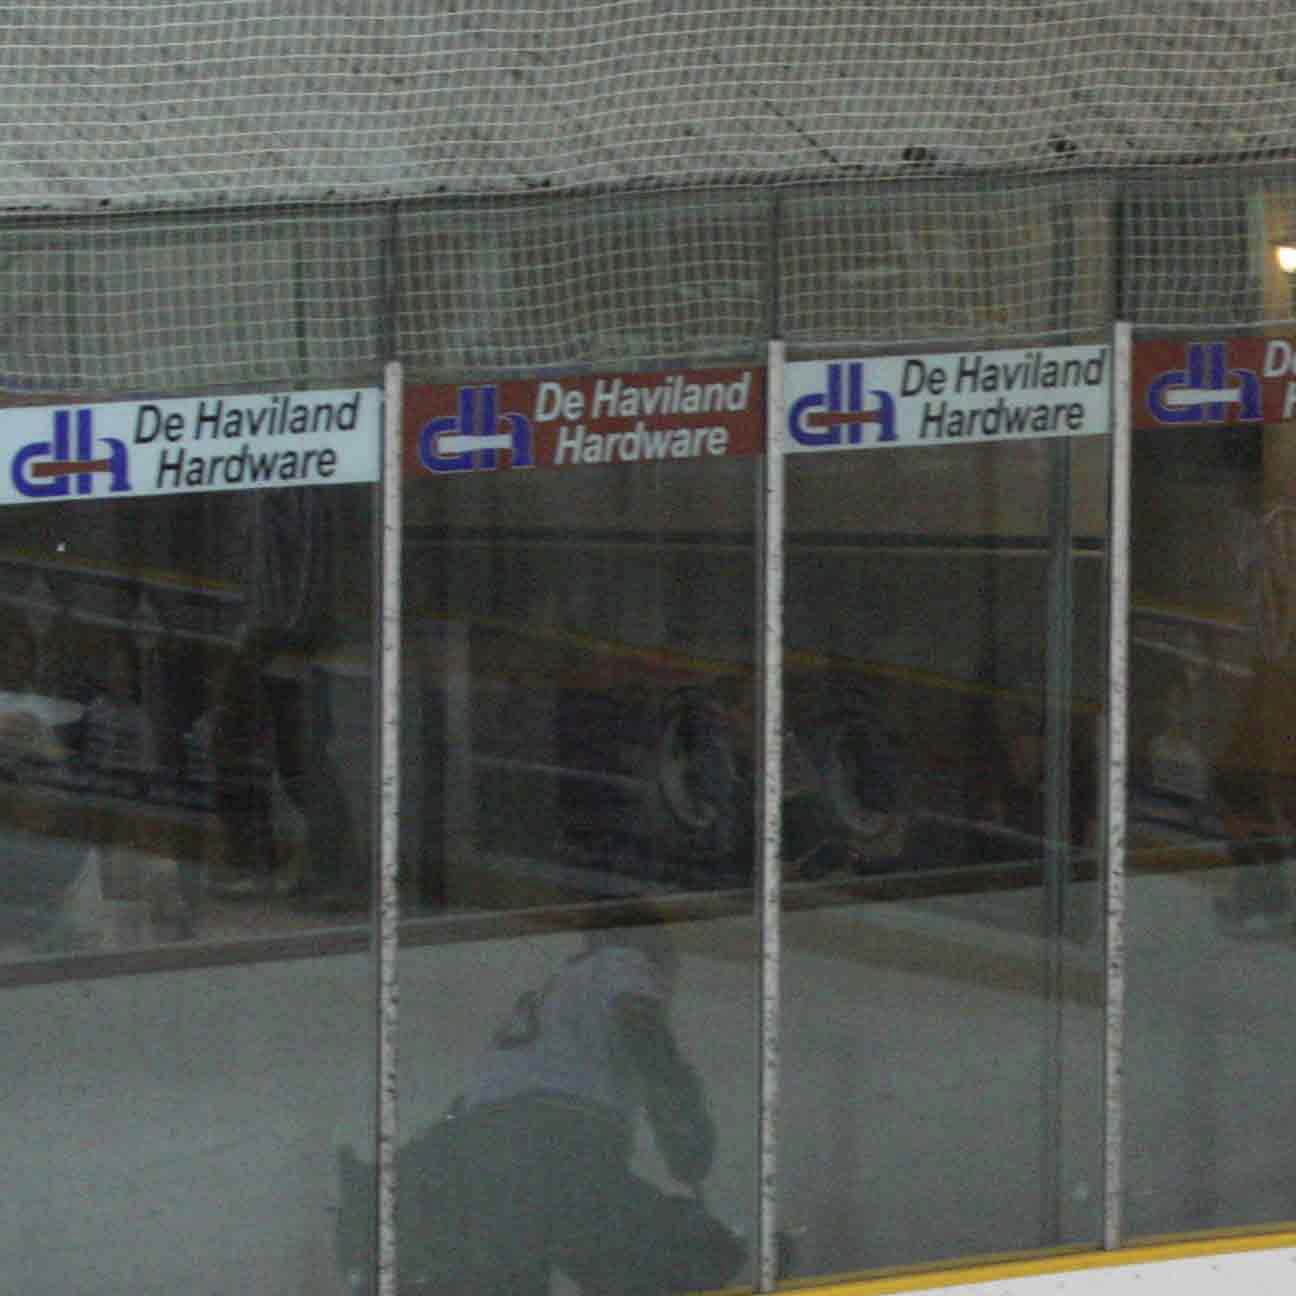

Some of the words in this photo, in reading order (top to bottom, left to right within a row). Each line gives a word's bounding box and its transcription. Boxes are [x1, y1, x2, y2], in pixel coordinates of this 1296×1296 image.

[899, 358, 946, 397] De
[957, 346, 1106, 393] Haviland
[134, 403, 184, 445] De
[195, 391, 361, 440] Haviland
[534, 380, 583, 422] De
[592, 373, 752, 418] Haviland
[919, 397, 1085, 440] Hardware
[156, 444, 337, 488] Hardware
[554, 424, 730, 466] Hardware
